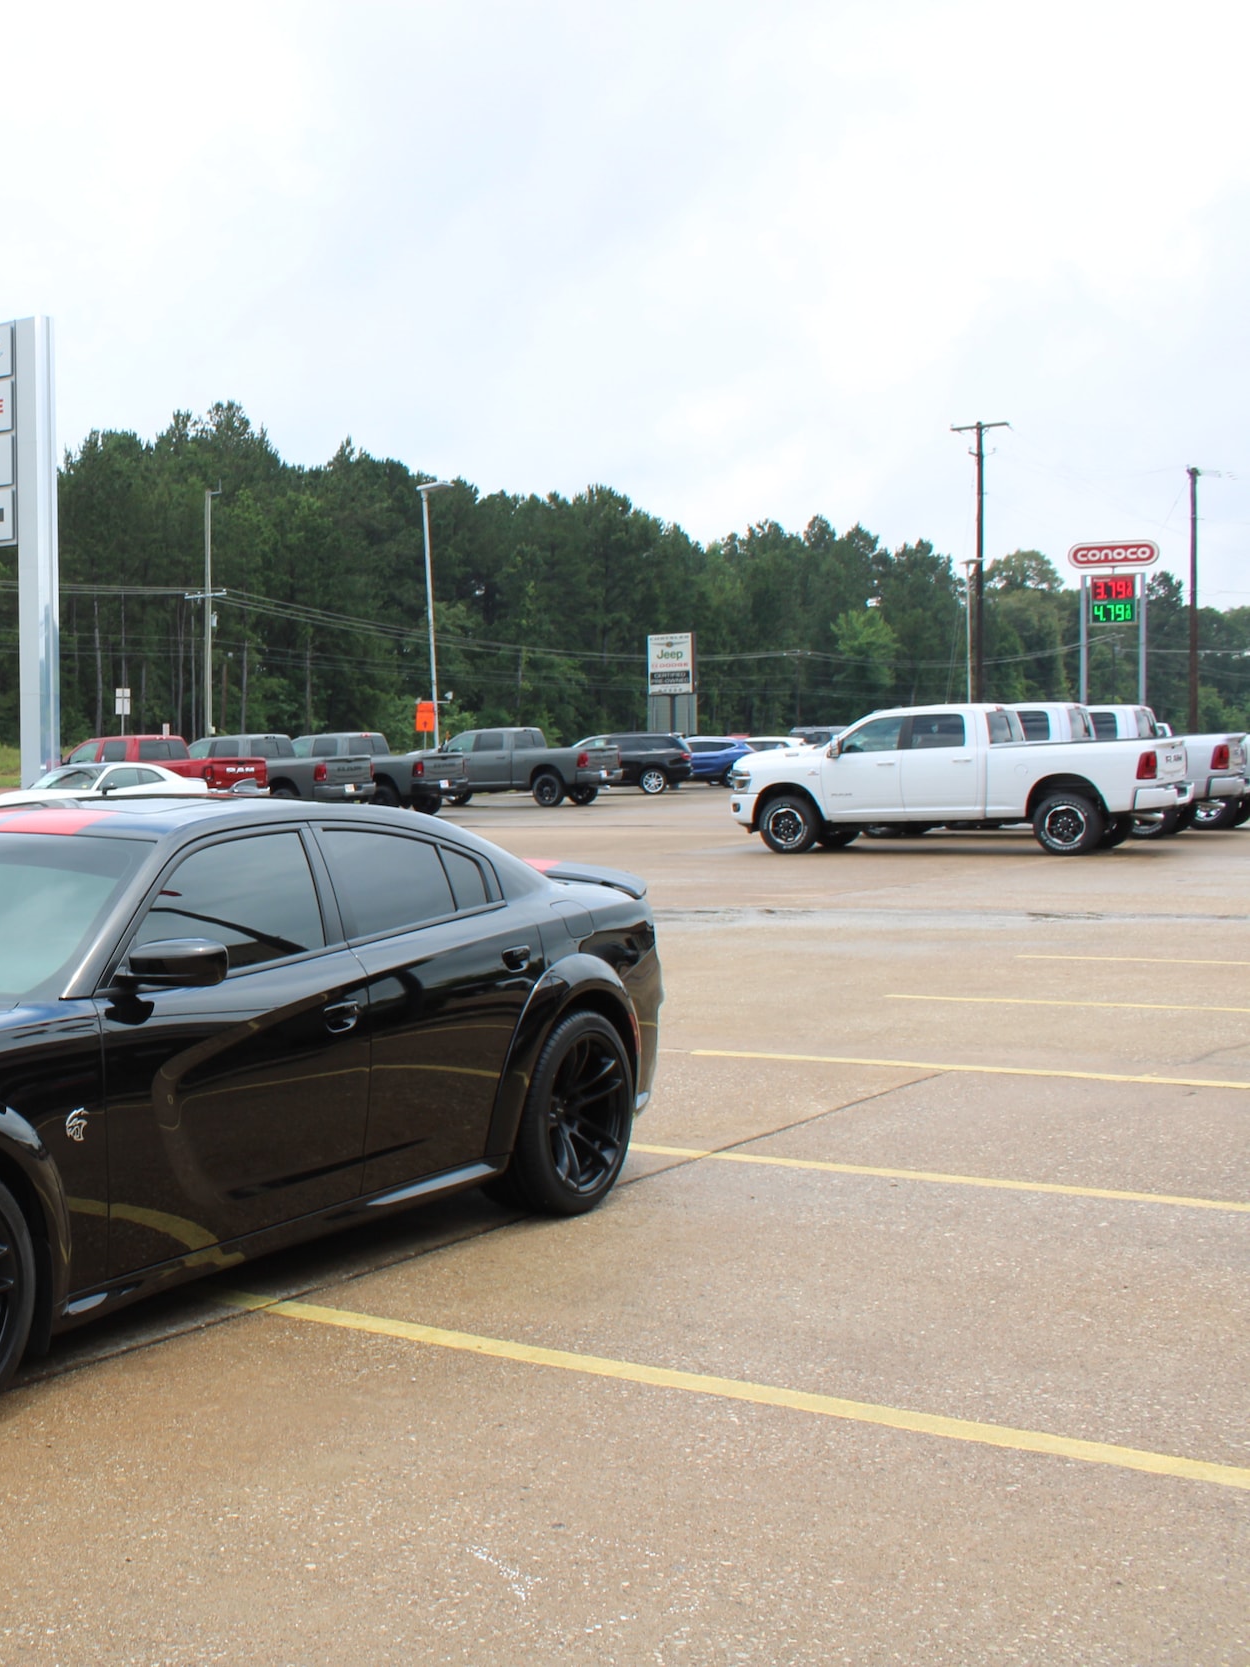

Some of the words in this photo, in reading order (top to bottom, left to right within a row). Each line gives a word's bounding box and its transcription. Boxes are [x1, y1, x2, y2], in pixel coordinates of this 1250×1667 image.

[656, 649, 684, 661] Jeep
[1165, 753, 1183, 764] RAM
[225, 766, 255, 774] RAM
